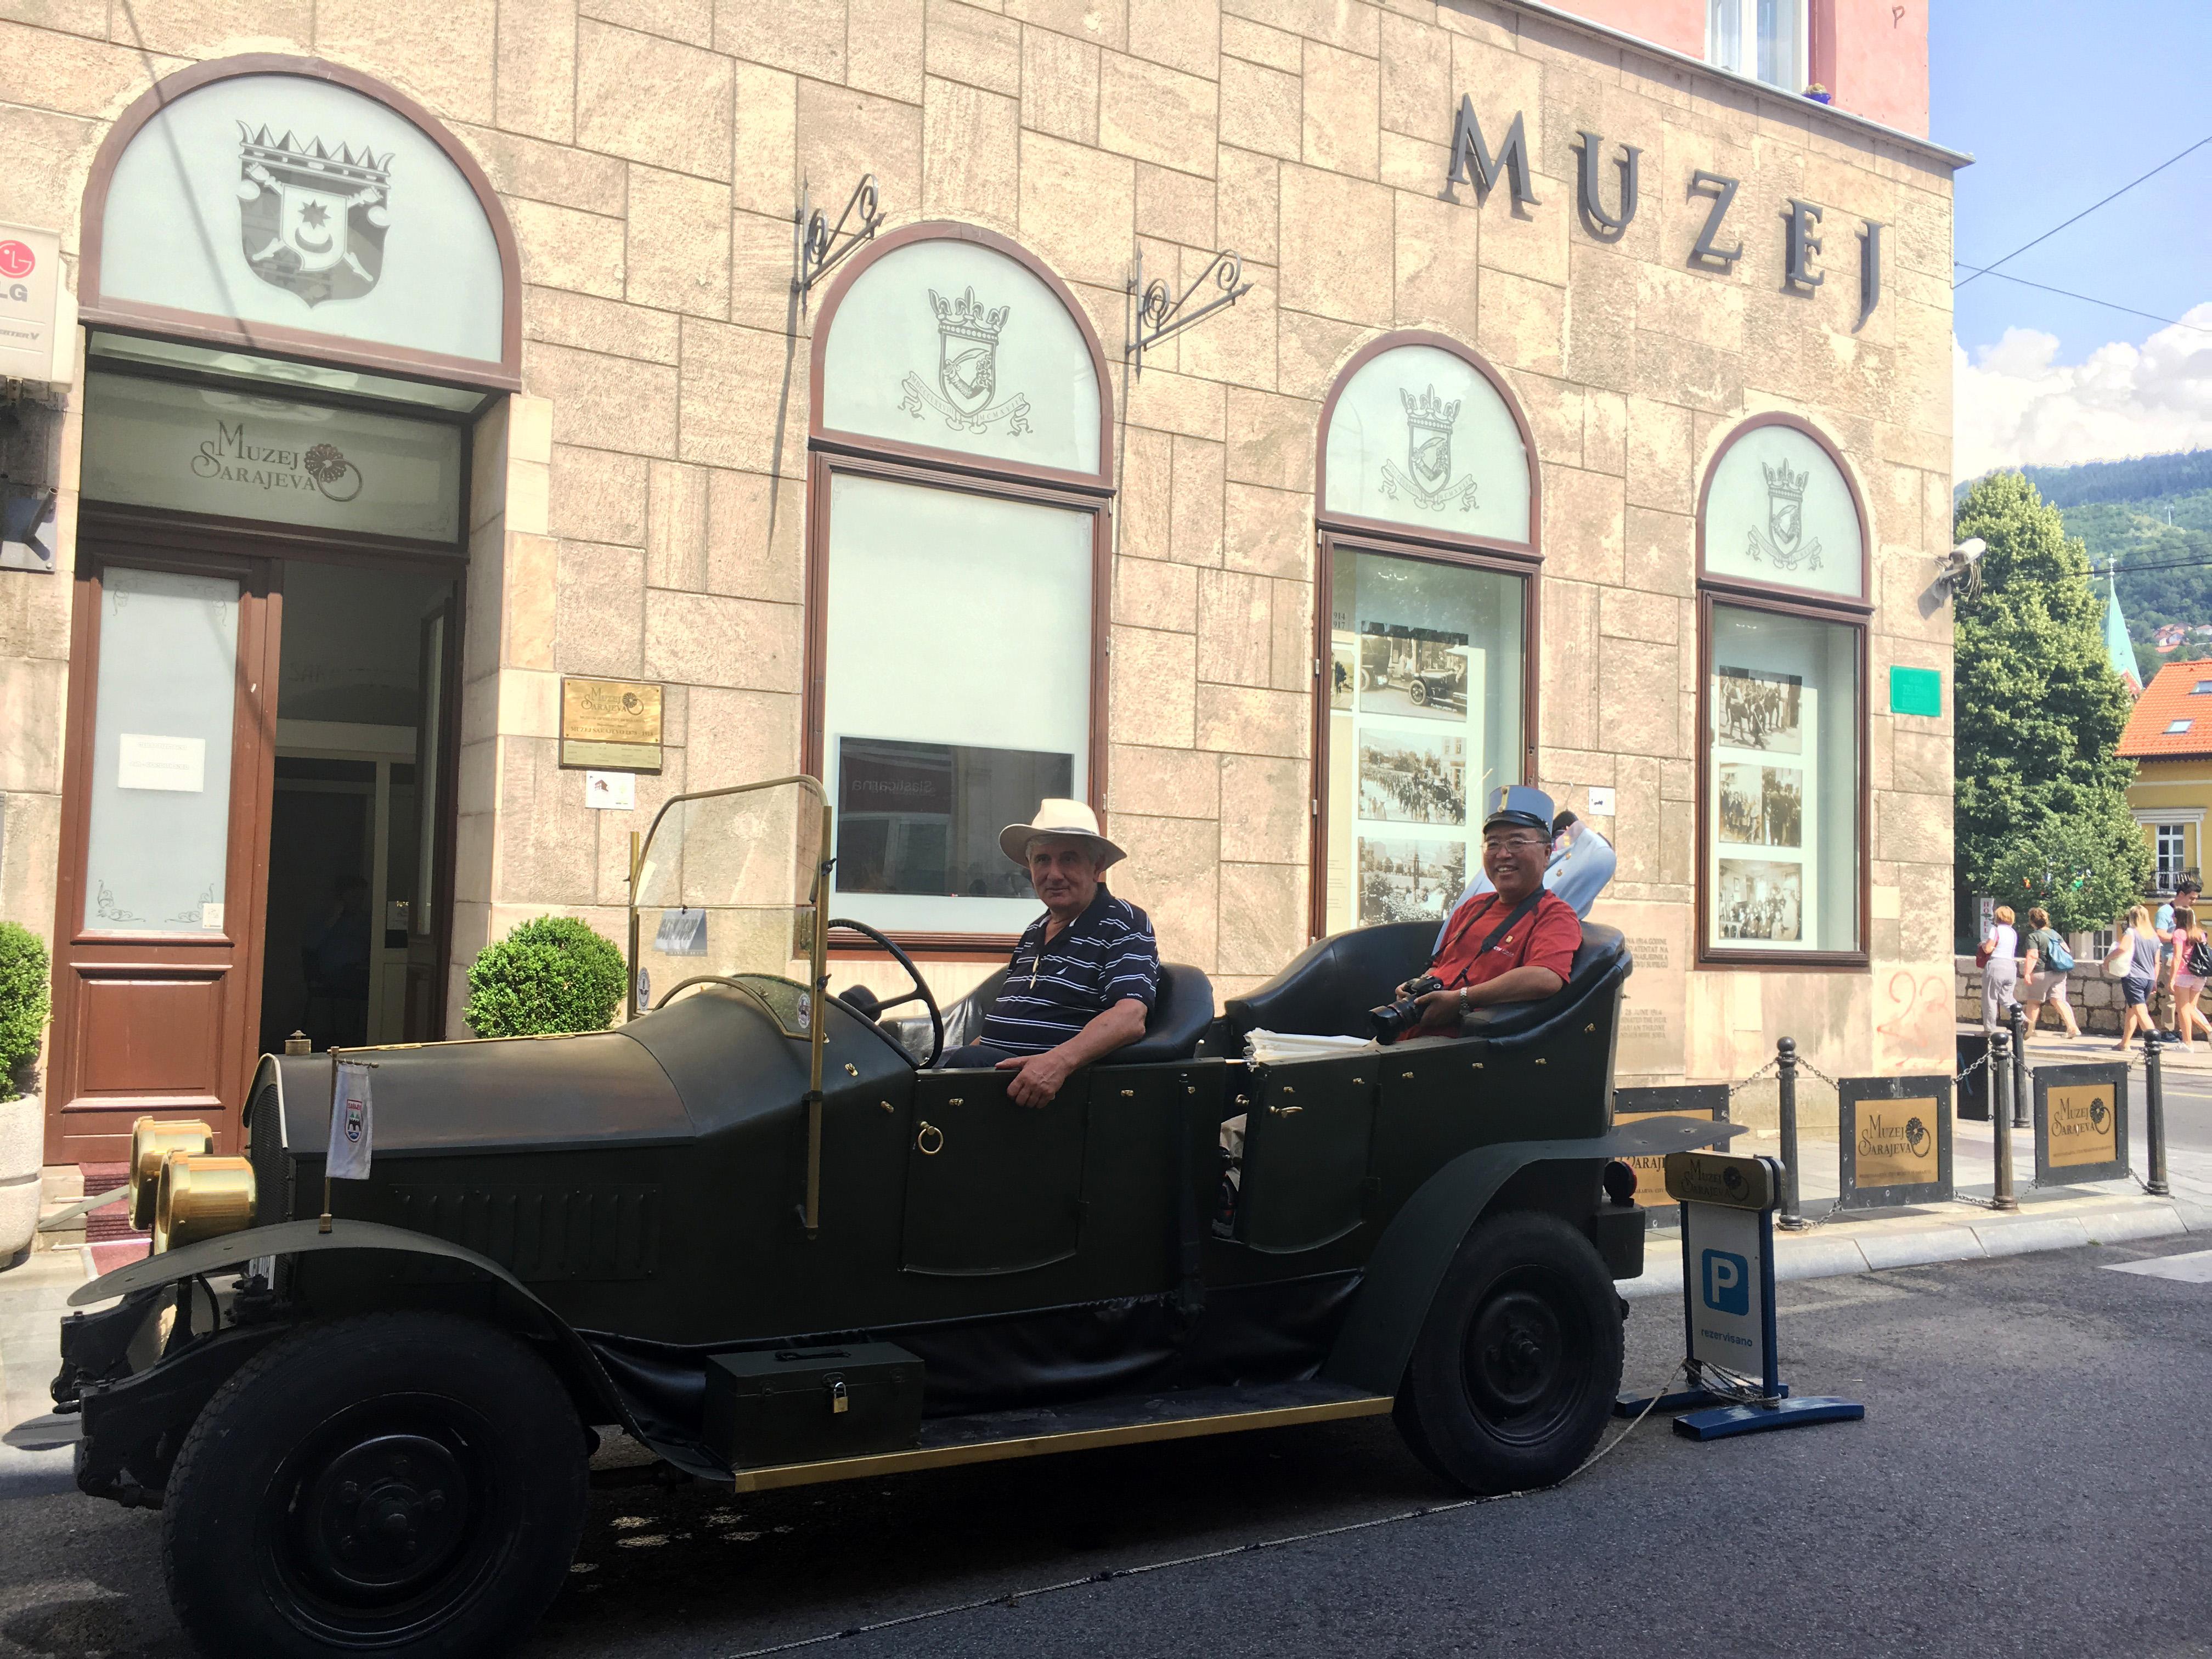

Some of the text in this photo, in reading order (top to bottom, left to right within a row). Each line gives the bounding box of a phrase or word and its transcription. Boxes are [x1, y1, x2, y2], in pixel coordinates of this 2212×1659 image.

[1445, 92, 1886, 333] MUZEJ
[1333, 612, 1345, 620] 914
[1711, 1256, 1739, 1304] P
[1701, 1328, 1753, 1347] rezervisano
